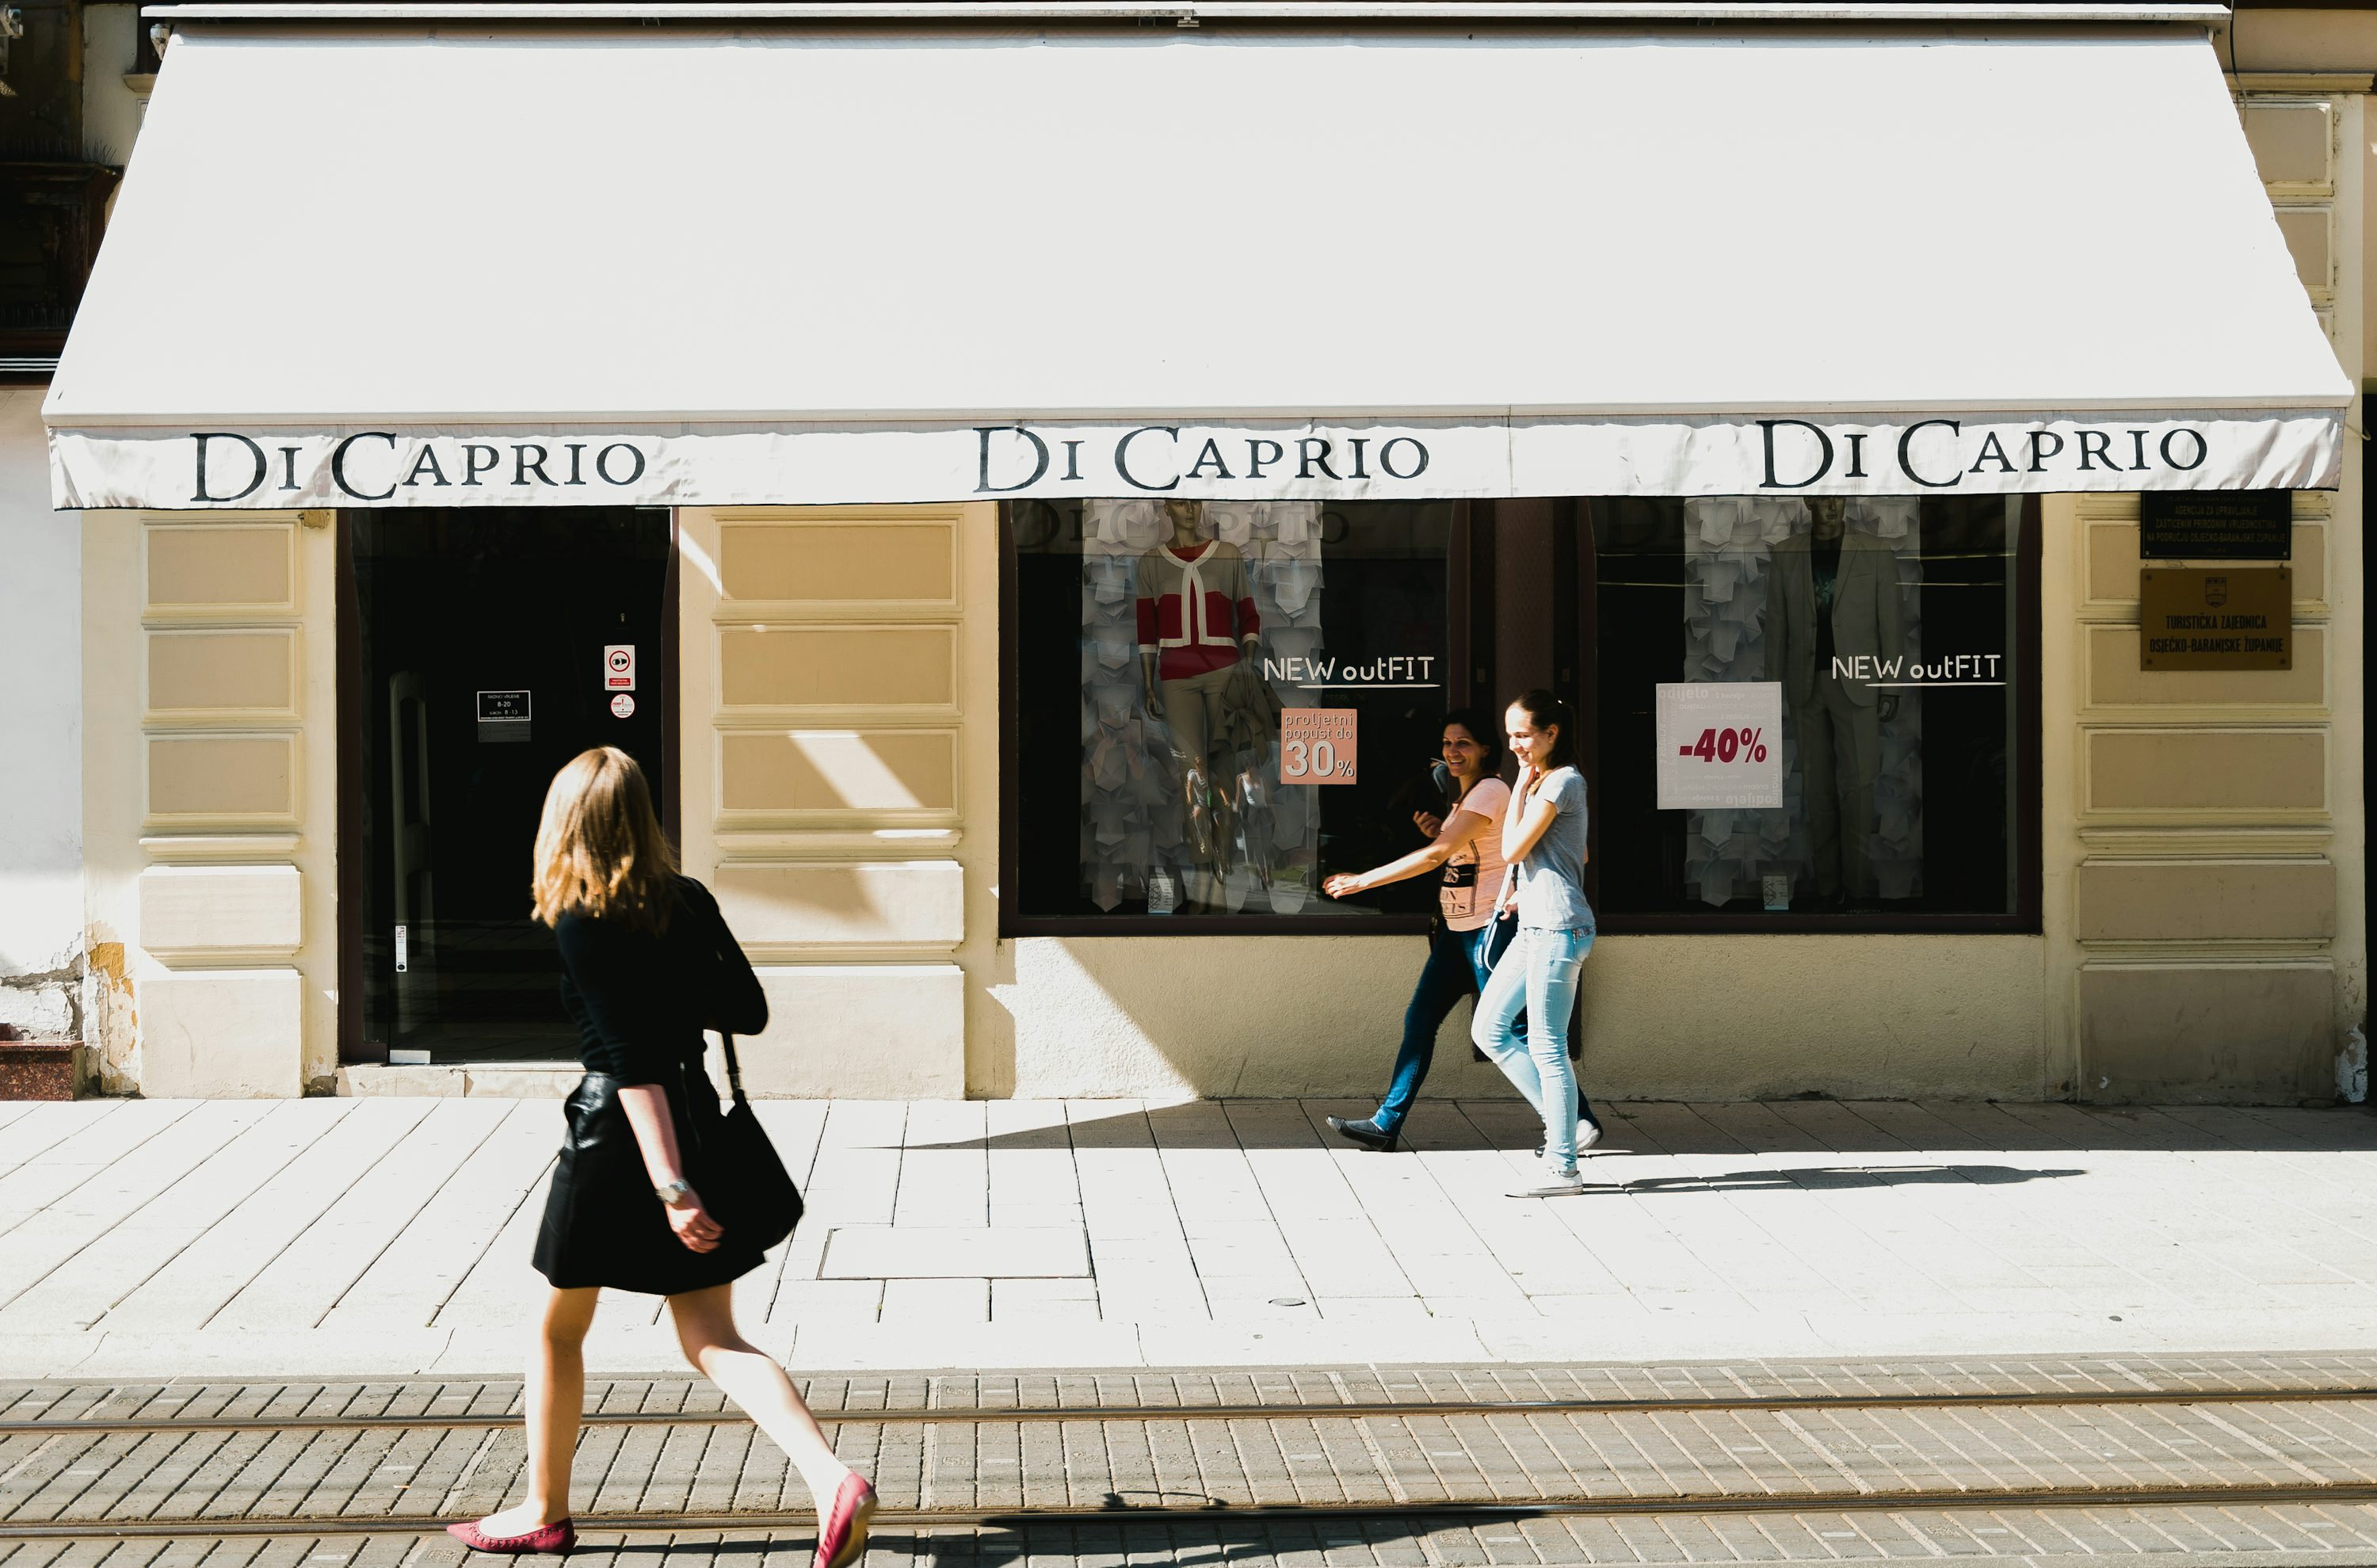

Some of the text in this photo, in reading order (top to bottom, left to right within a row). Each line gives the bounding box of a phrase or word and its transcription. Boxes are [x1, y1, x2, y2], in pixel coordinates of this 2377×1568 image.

[973, 426, 1429, 492] DI CAPRIO
[1756, 420, 2207, 488] DI CAPRIO
[190, 432, 646, 502] DI CAPRIO
[2206, 505, 2213, 515] ZA
[2165, 612, 2267, 630] TURISTIČKA ZAJEDNICA
[2150, 636, 2284, 653] OSJEČKO-BARANJSKE ŽUPANIJE
[1264, 657, 1435, 681] NEW outFIT
[1832, 654, 2001, 680] NEW outFIT
[1285, 712, 1354, 728] proljetni
[1285, 727, 1353, 742] popust do
[1679, 728, 1767, 763] -40%
[1285, 740, 1355, 776] 30%
